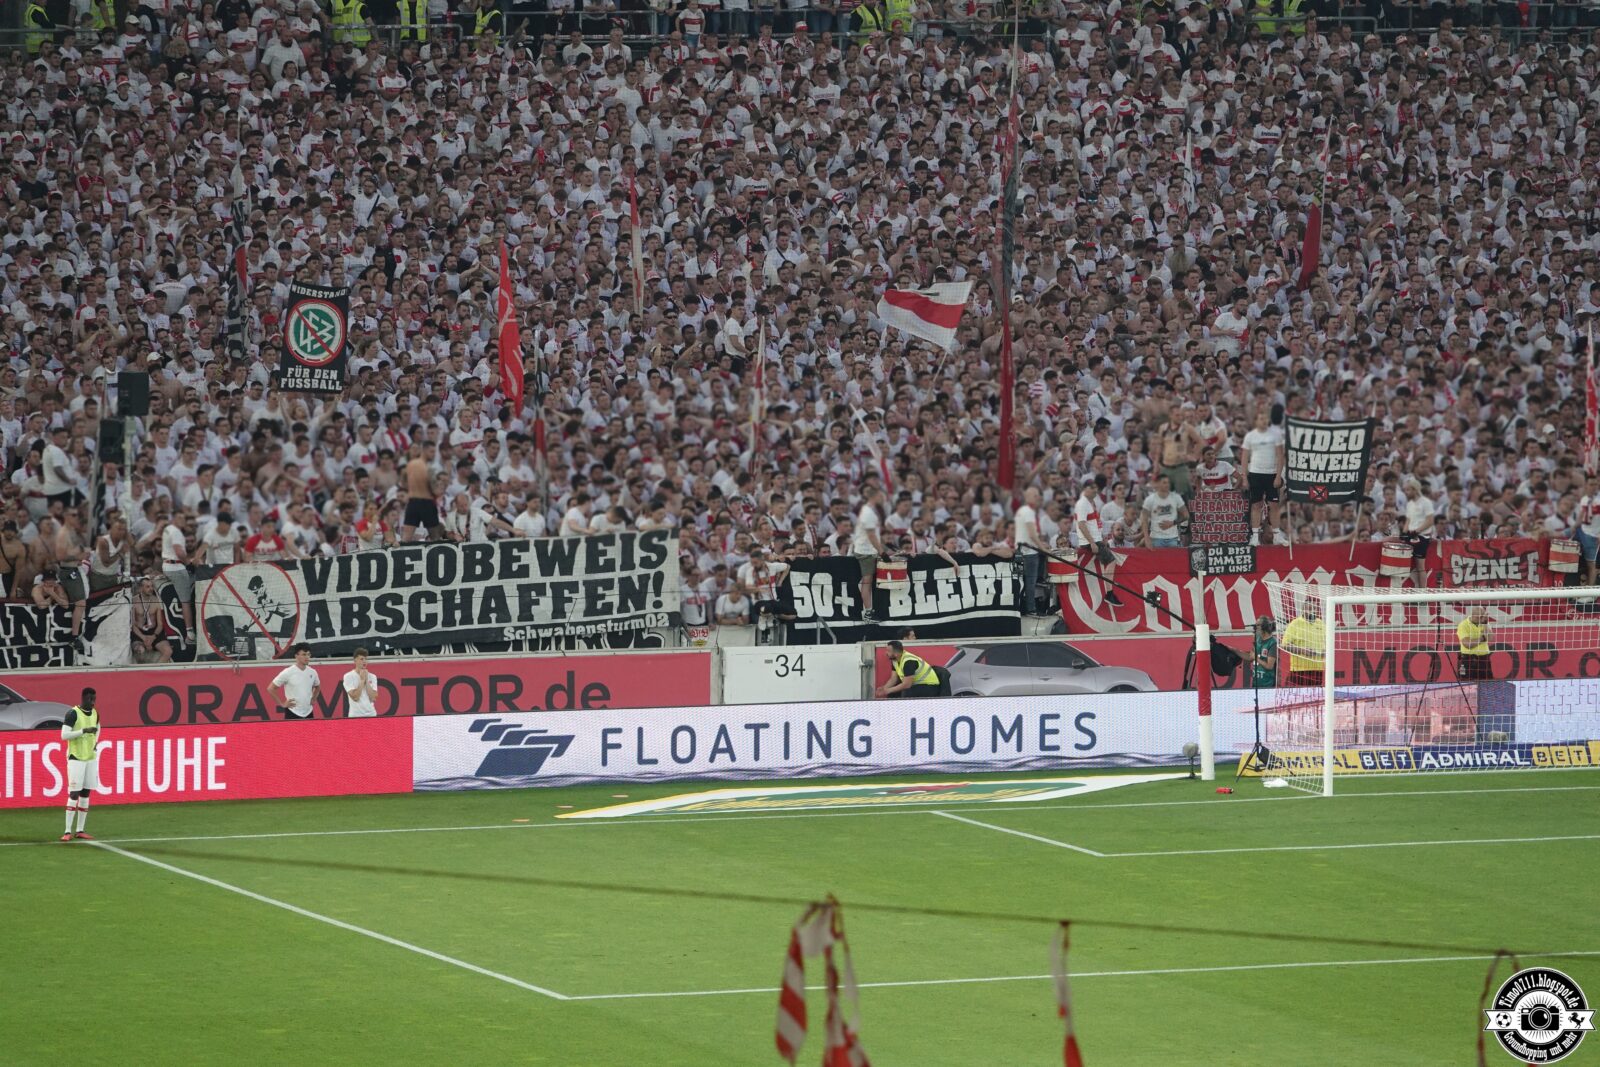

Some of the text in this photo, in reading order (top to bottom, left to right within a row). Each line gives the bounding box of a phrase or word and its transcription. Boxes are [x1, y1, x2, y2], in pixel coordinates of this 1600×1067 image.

[287, 366, 338, 381] FÜR DEN
[280, 378, 343, 391] FUSSBALL
[1288, 425, 1366, 452] VIDEO
[1288, 449, 1362, 471] BEWEIS
[1288, 469, 1359, 483] ABSCHAFFEN!
[1195, 491, 1243, 500] JEDER
[1195, 512, 1244, 522] KEHRT
[1191, 532, 1248, 543] ZURÜCK
[1208, 546, 1251, 556] DU BIST
[1208, 555, 1252, 566] IMMER
[300, 529, 669, 595] VIDEOBEWEIS
[1208, 564, 1253, 574] BEI UNS!
[1451, 552, 1540, 585] SZENE E
[790, 562, 1015, 618] 50+ BLEIBT
[304, 571, 665, 640] ABSCHAFFEN!
[504, 613, 669, 642] Schwabensturm02
[775, 654, 806, 678] 34
[601, 712, 1097, 767] FLOATING HOMES
[0, 736, 227, 798] ITSCHUHE
[1363, 753, 1407, 768] BET
[1422, 749, 1583, 768] ADMIRAL BET
